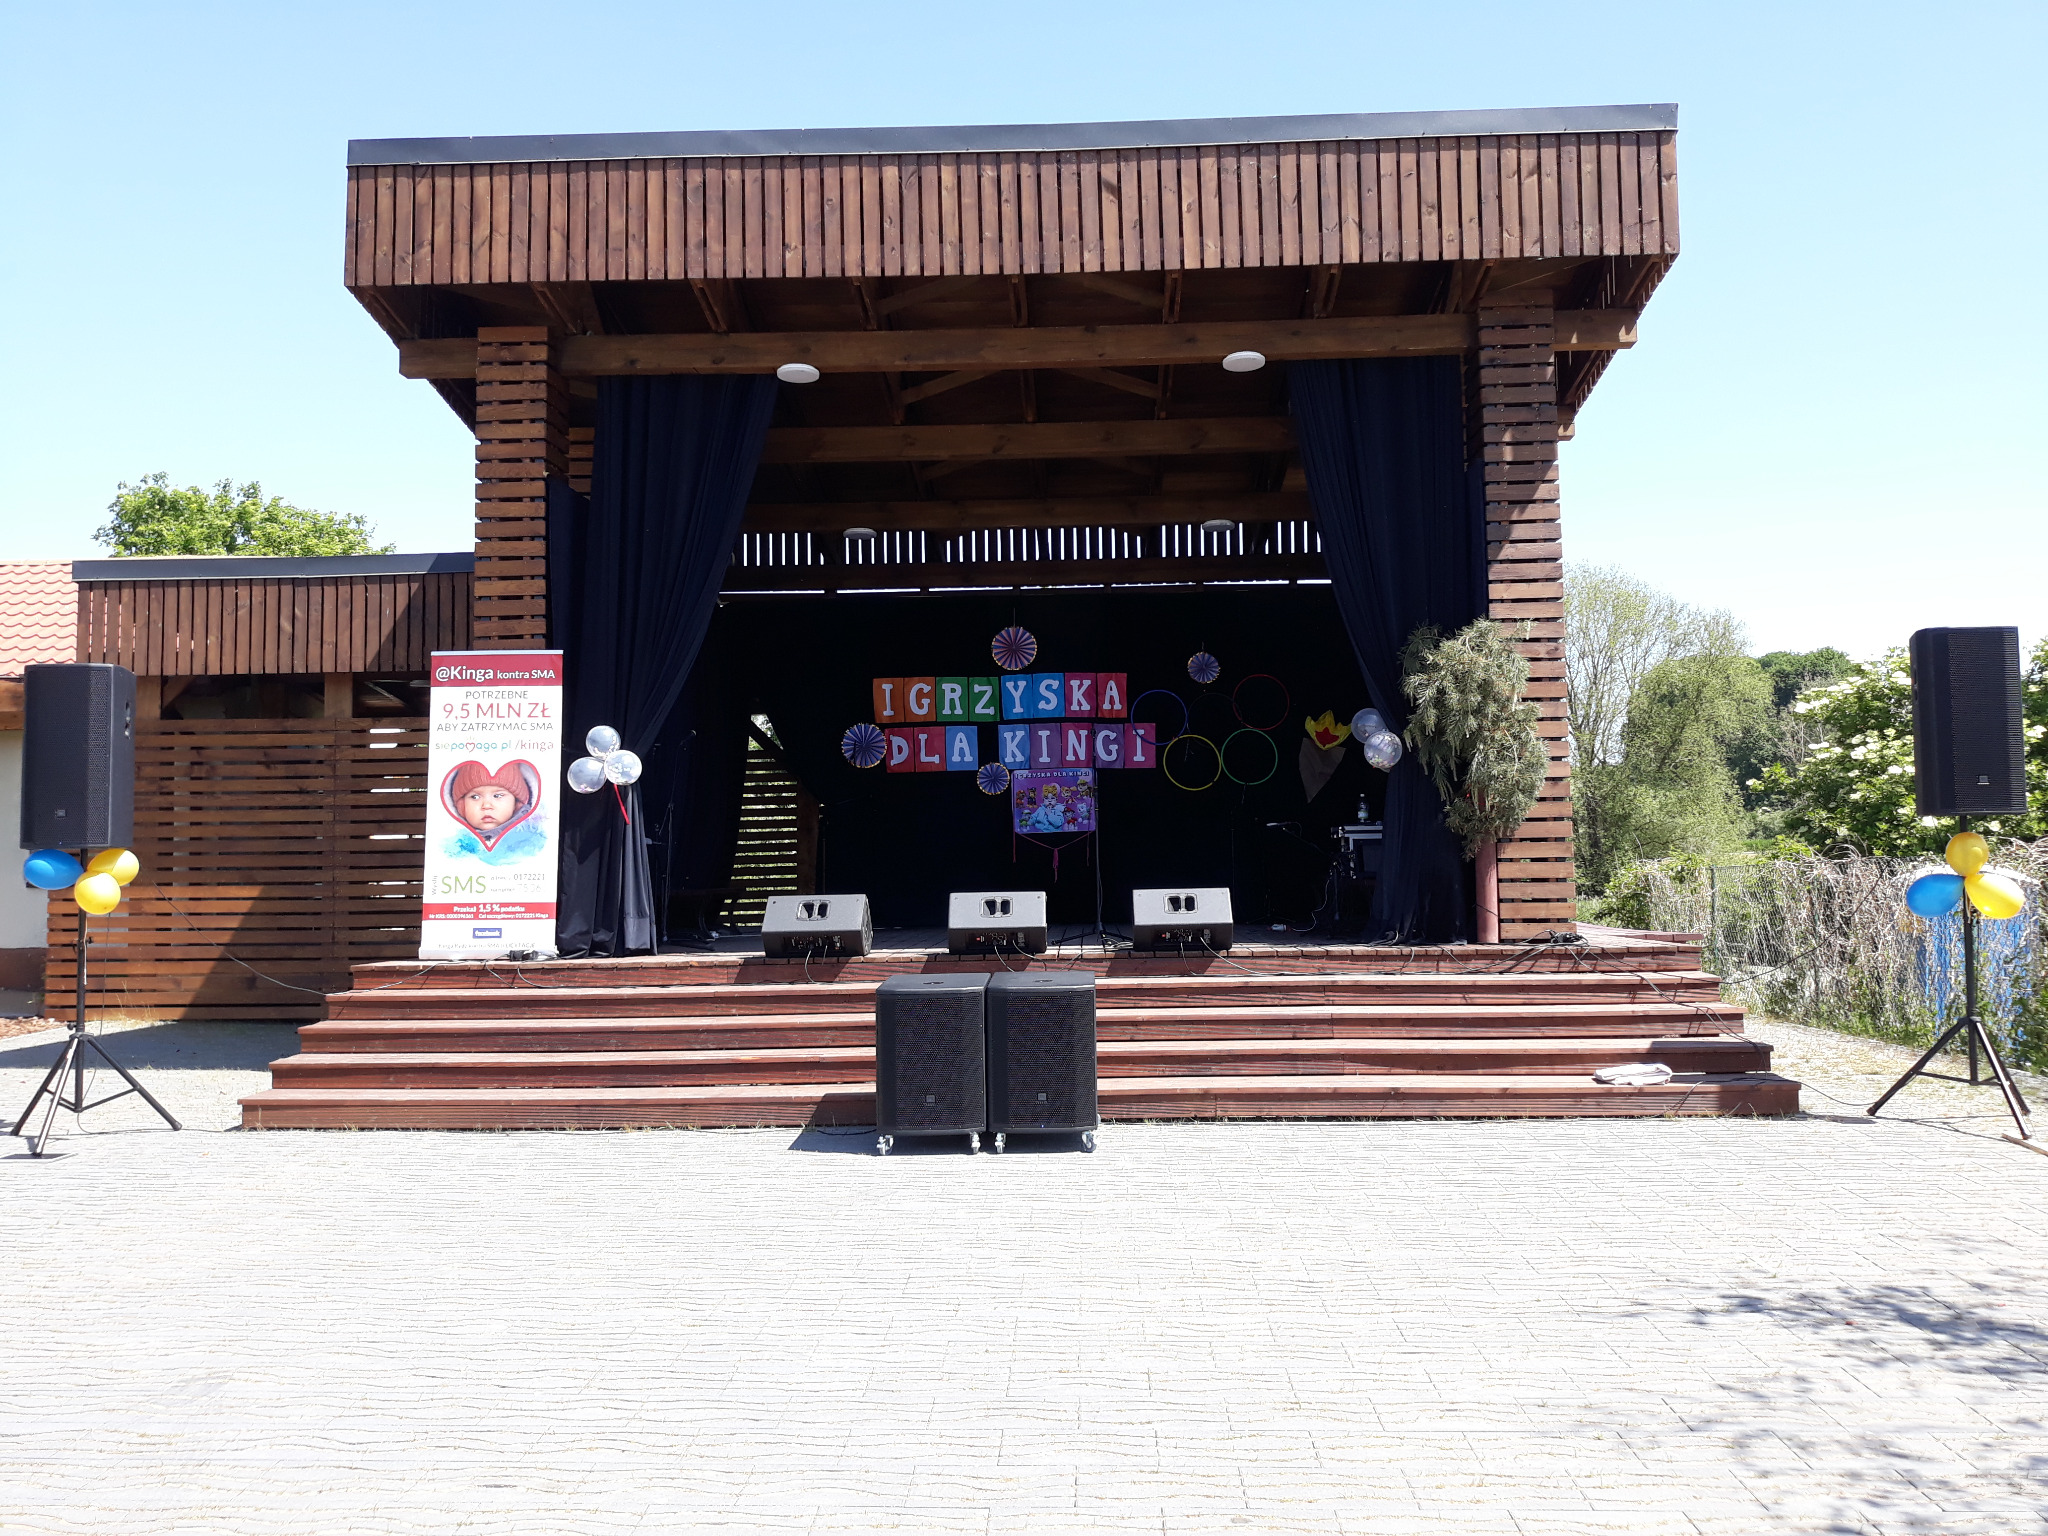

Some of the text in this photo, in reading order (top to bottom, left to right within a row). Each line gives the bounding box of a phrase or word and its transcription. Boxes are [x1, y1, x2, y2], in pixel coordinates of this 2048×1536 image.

[436, 666, 556, 682] @Kinga kontra SMA
[465, 691, 528, 700] POTRZEBNE
[881, 679, 1122, 717] IGRZYSKA
[443, 702, 551, 720] 9,5 MLN ZŁ
[437, 723, 458, 732] ABY
[530, 722, 553, 731] SMA
[435, 740, 512, 752] siepomagapl
[889, 729, 1146, 766] DLA KINGI
[441, 875, 486, 894] SMS
